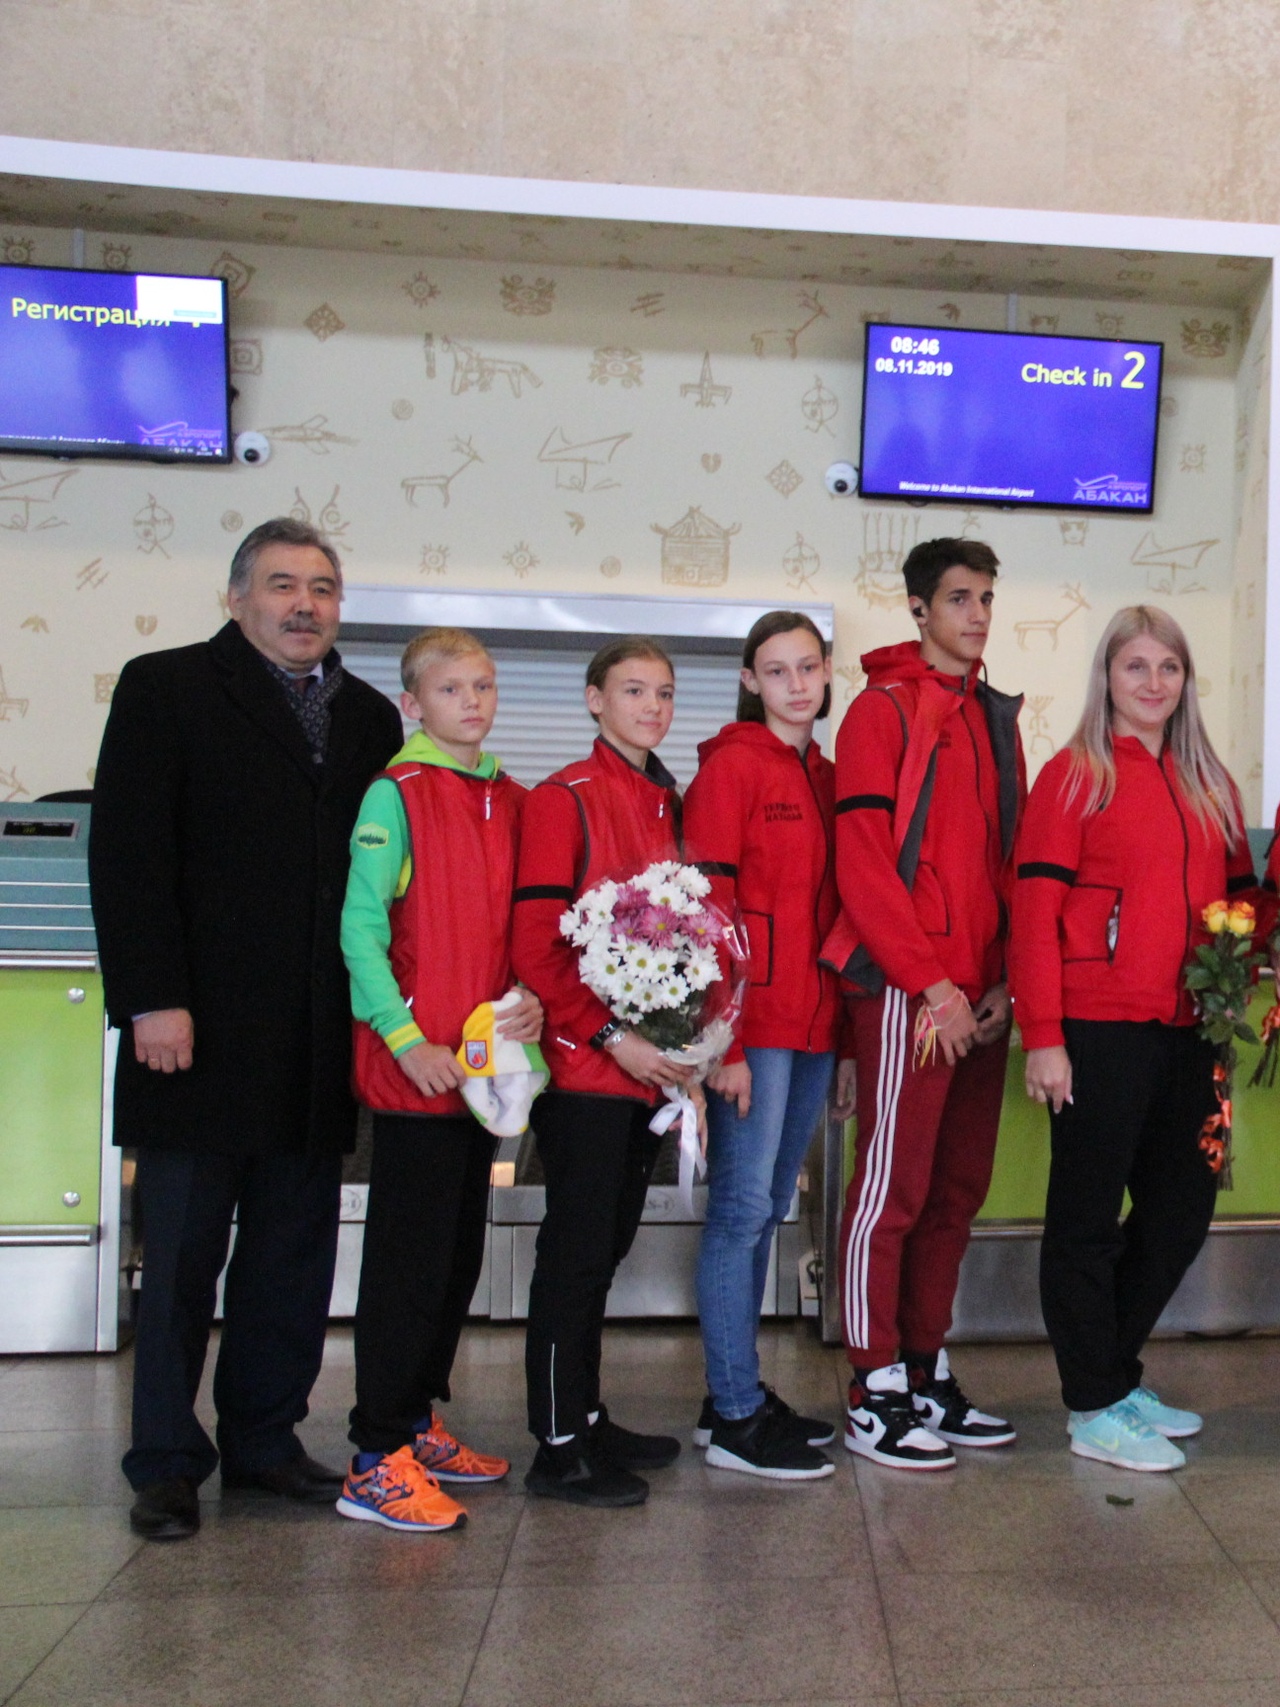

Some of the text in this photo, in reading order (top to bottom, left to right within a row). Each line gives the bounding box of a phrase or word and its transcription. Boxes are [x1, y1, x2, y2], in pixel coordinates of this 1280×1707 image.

[890, 336, 940, 356] 08:46
[1021, 350, 1146, 390] Check in 2
[1073, 489, 1148, 504] АБАКАН
